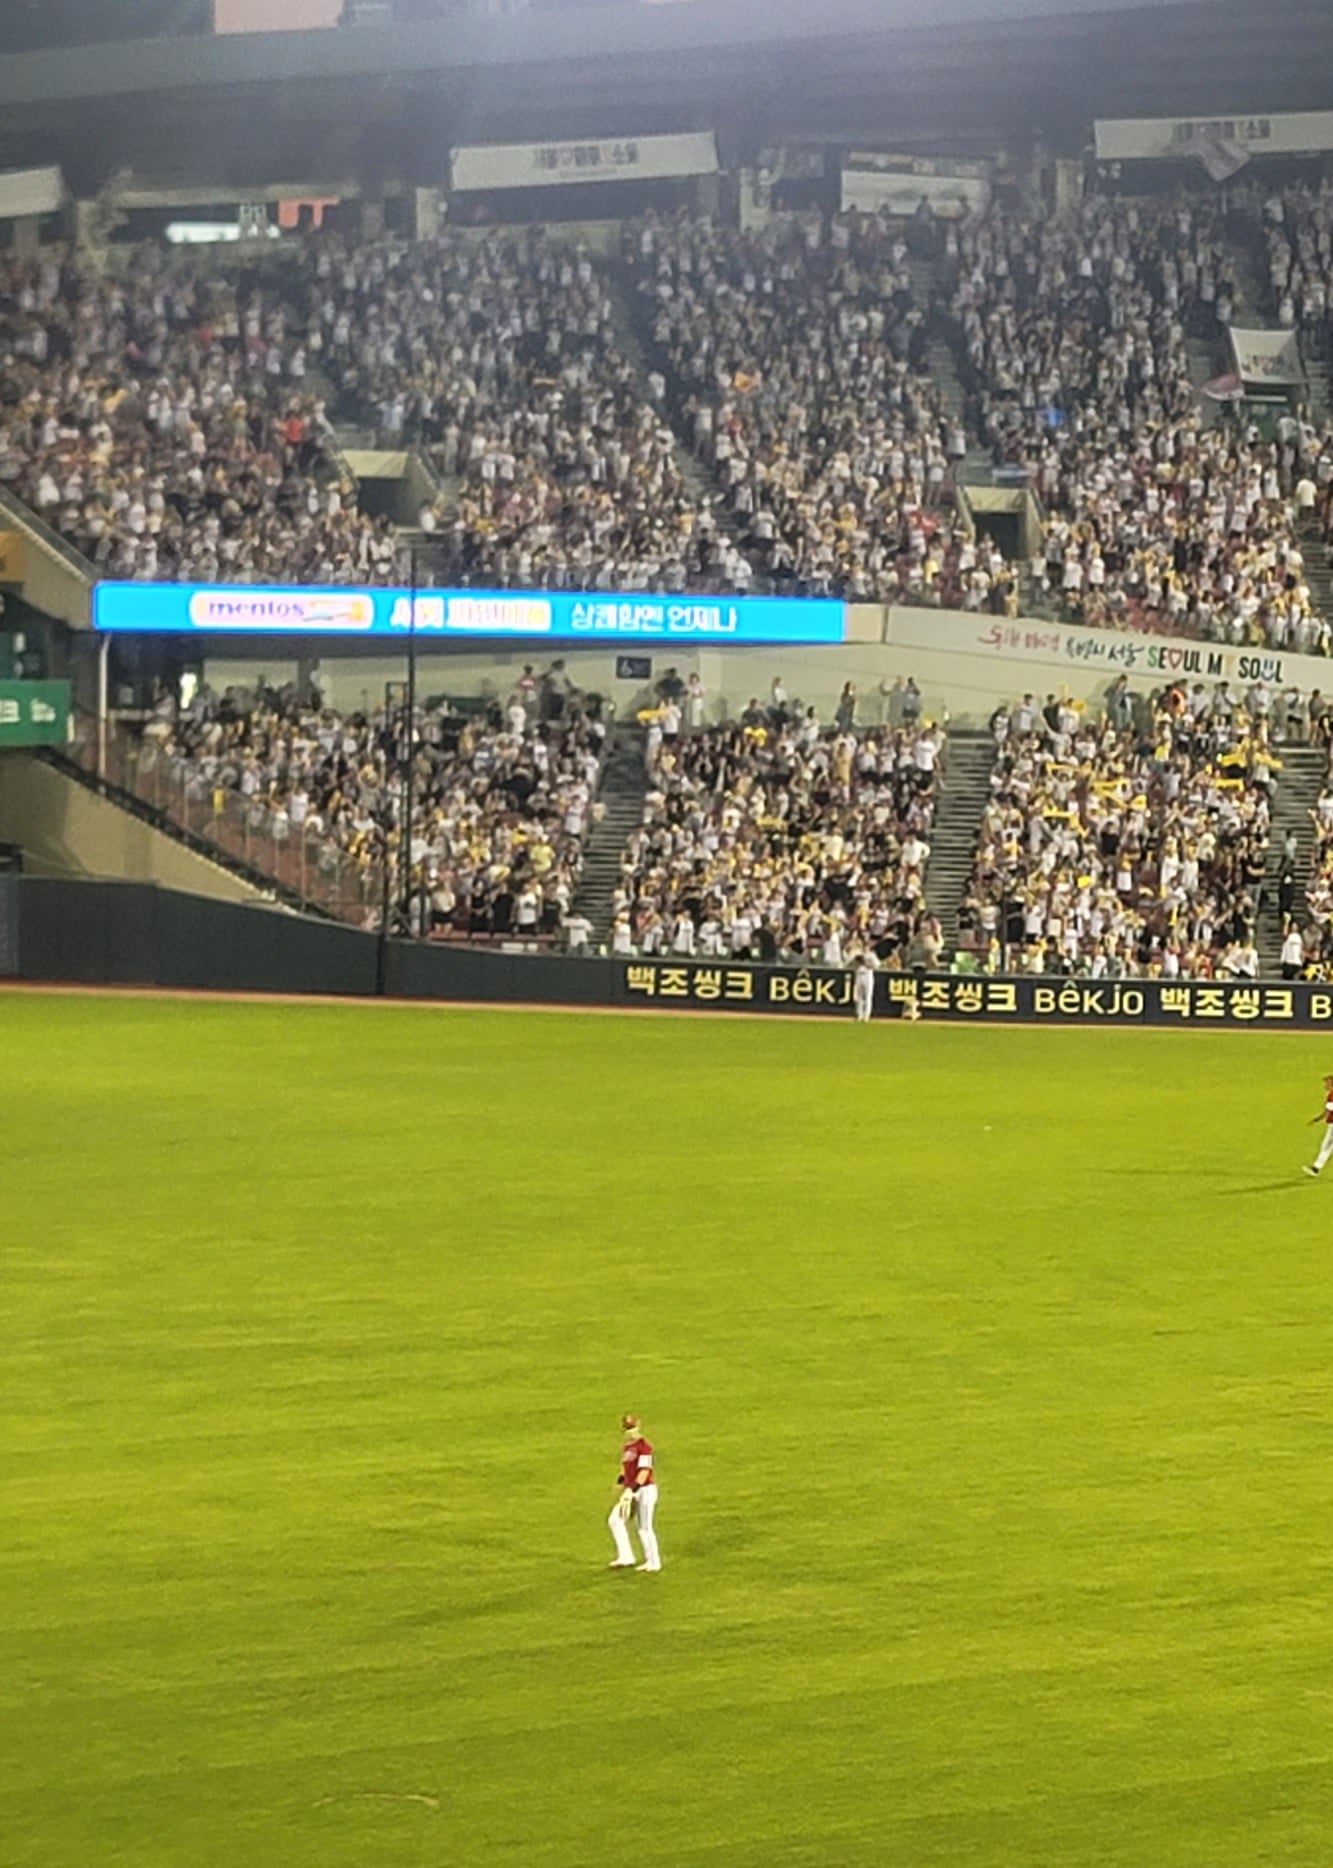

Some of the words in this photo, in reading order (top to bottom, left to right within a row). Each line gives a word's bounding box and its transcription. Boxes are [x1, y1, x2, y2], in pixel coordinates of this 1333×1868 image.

[208, 601, 305, 618] mentos
[626, 966, 753, 1000] 백조씽크
[888, 976, 1017, 1012] 백조씽크
[1160, 987, 1293, 1019] 백조씽크
